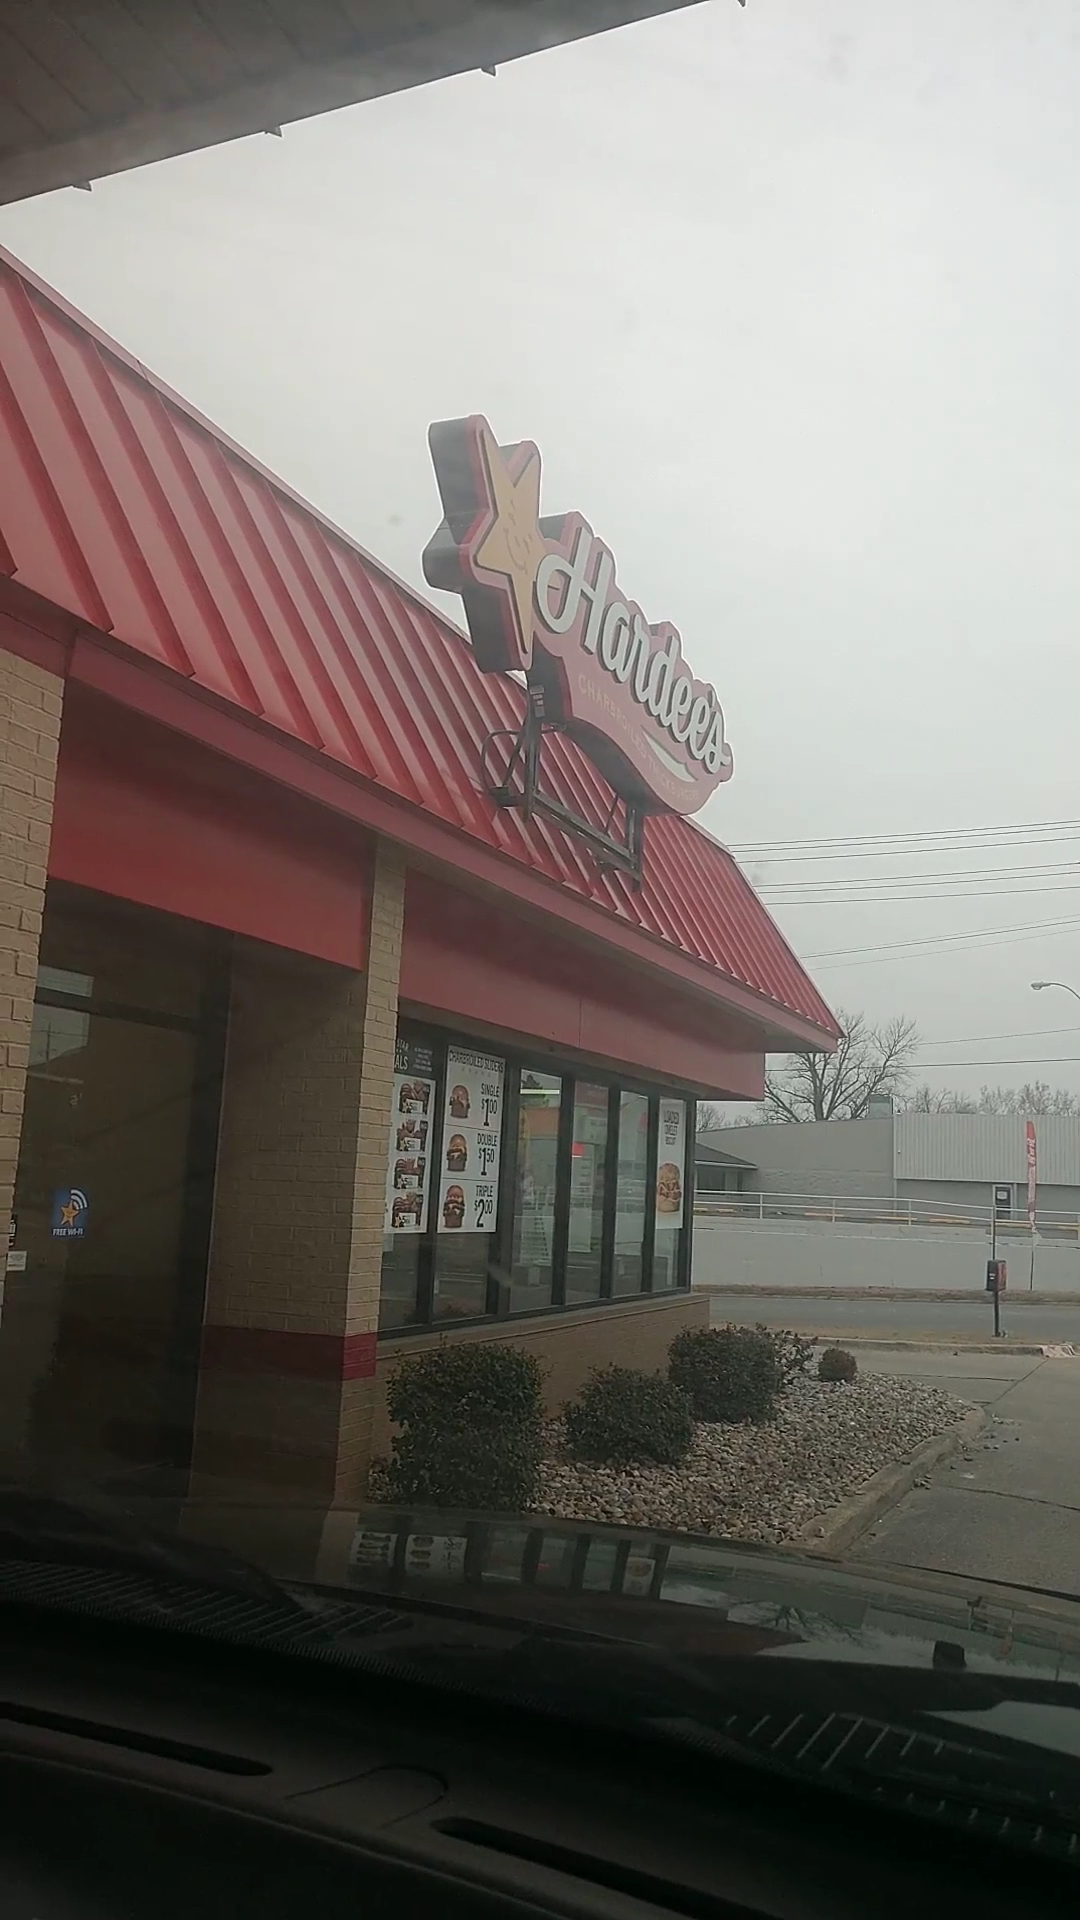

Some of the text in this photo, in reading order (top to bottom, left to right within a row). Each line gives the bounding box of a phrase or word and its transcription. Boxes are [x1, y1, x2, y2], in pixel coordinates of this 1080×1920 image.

[536, 527, 731, 774] Hardee's
[394, 1055, 408, 1070] ALS
[481, 1083, 499, 1097] SINGLE
[477, 1133, 498, 1146] DOUBLE
[476, 1185, 493, 1197] TRIPLE
[52, 1228, 67, 1236] FREE
